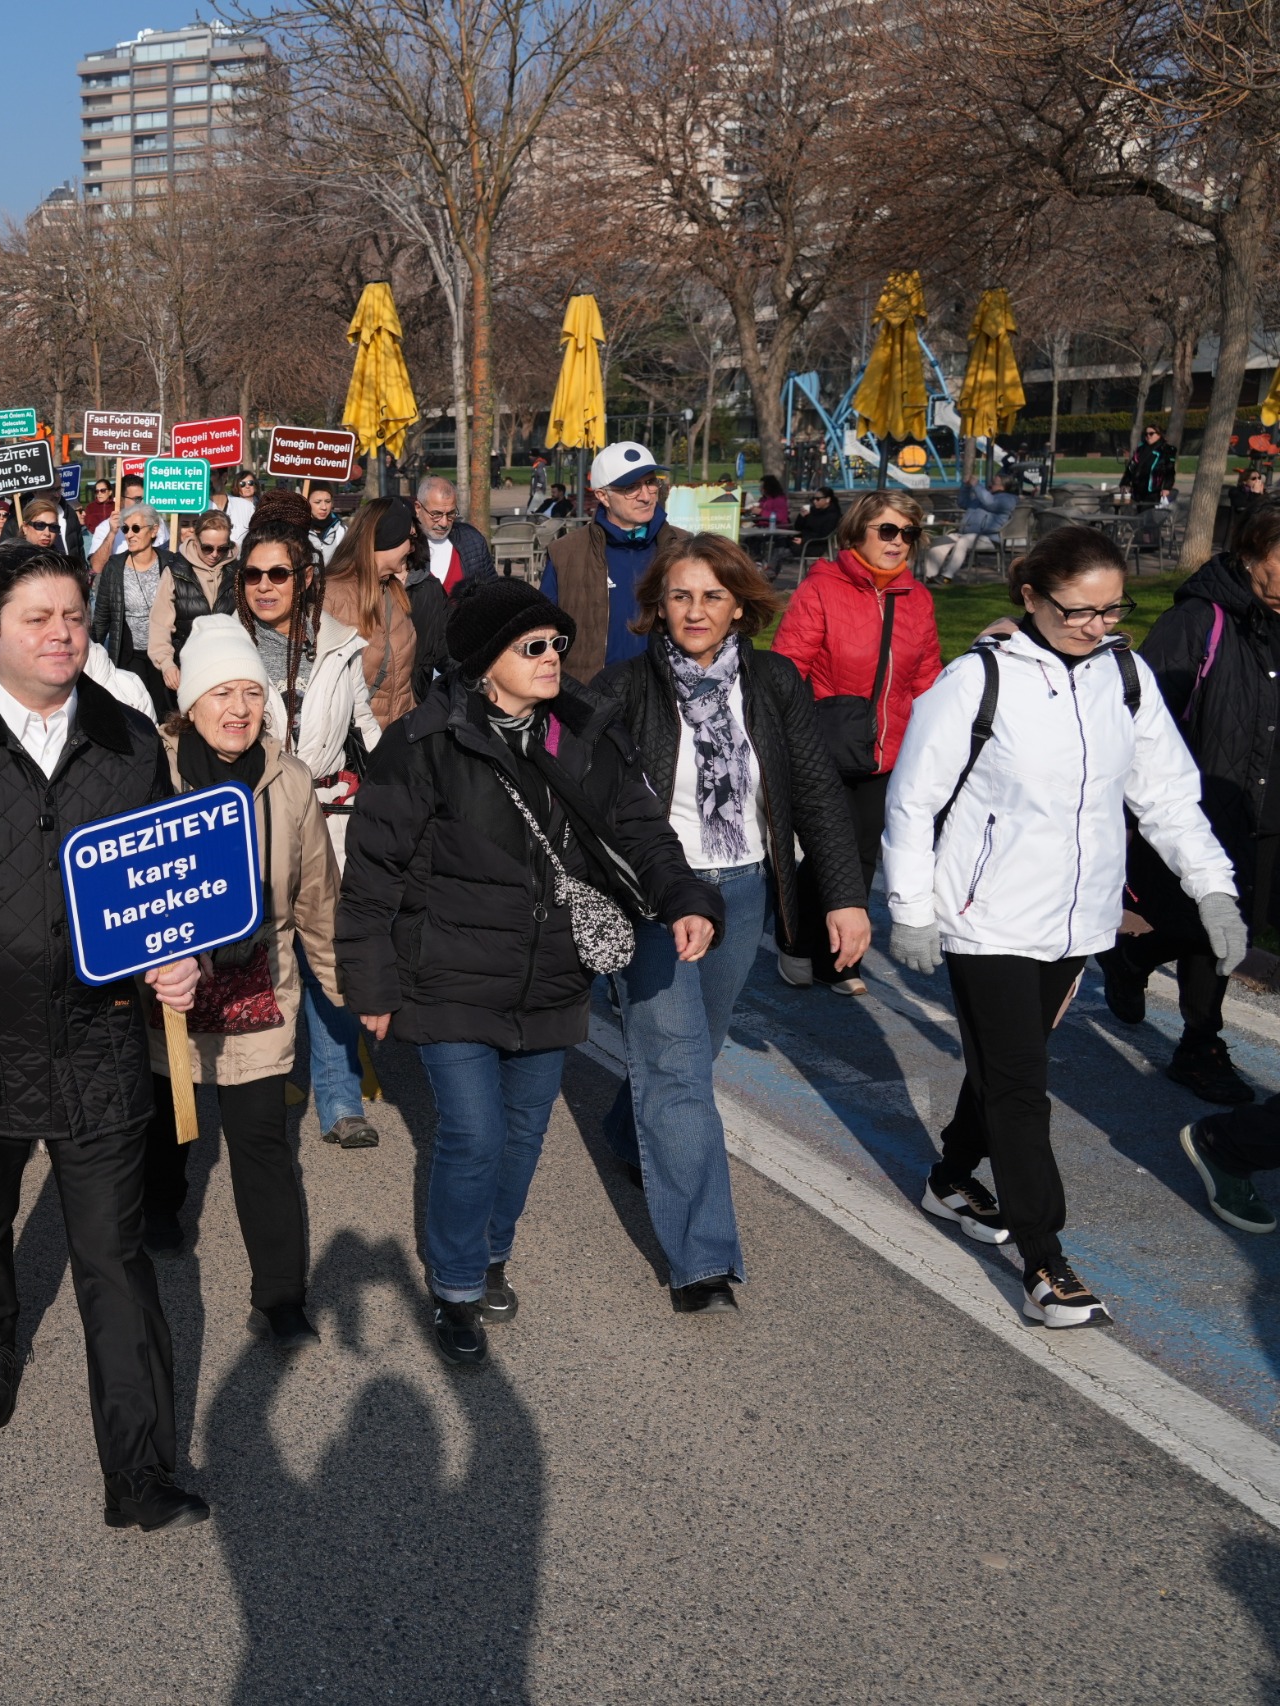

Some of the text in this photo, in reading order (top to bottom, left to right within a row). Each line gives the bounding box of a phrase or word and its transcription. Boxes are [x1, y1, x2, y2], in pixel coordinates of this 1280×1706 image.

[89, 415, 157, 427] Fast Food Değil,
[93, 428, 152, 439] Besleyici Gıda
[175, 428, 239, 444] Dengeli Yemek,
[103, 441, 140, 451] Tercih Et
[201, 444, 233, 456] Hareket
[275, 437, 350, 454] Yemeğim Dengeli
[274, 453, 347, 468] Sağlığım Güvenli
[14, 464, 31, 472] De,
[152, 467, 181, 477] Sağlık
[185, 467, 202, 477] için
[21, 475, 45, 485] Yaşa
[150, 482, 202, 490] HAREKETE
[150, 496, 176, 504] önem
[76, 801, 239, 869] OBEZİTEYE
[127, 854, 197, 889] karşı
[103, 878, 228, 930] harekete
[145, 921, 195, 953] geç
